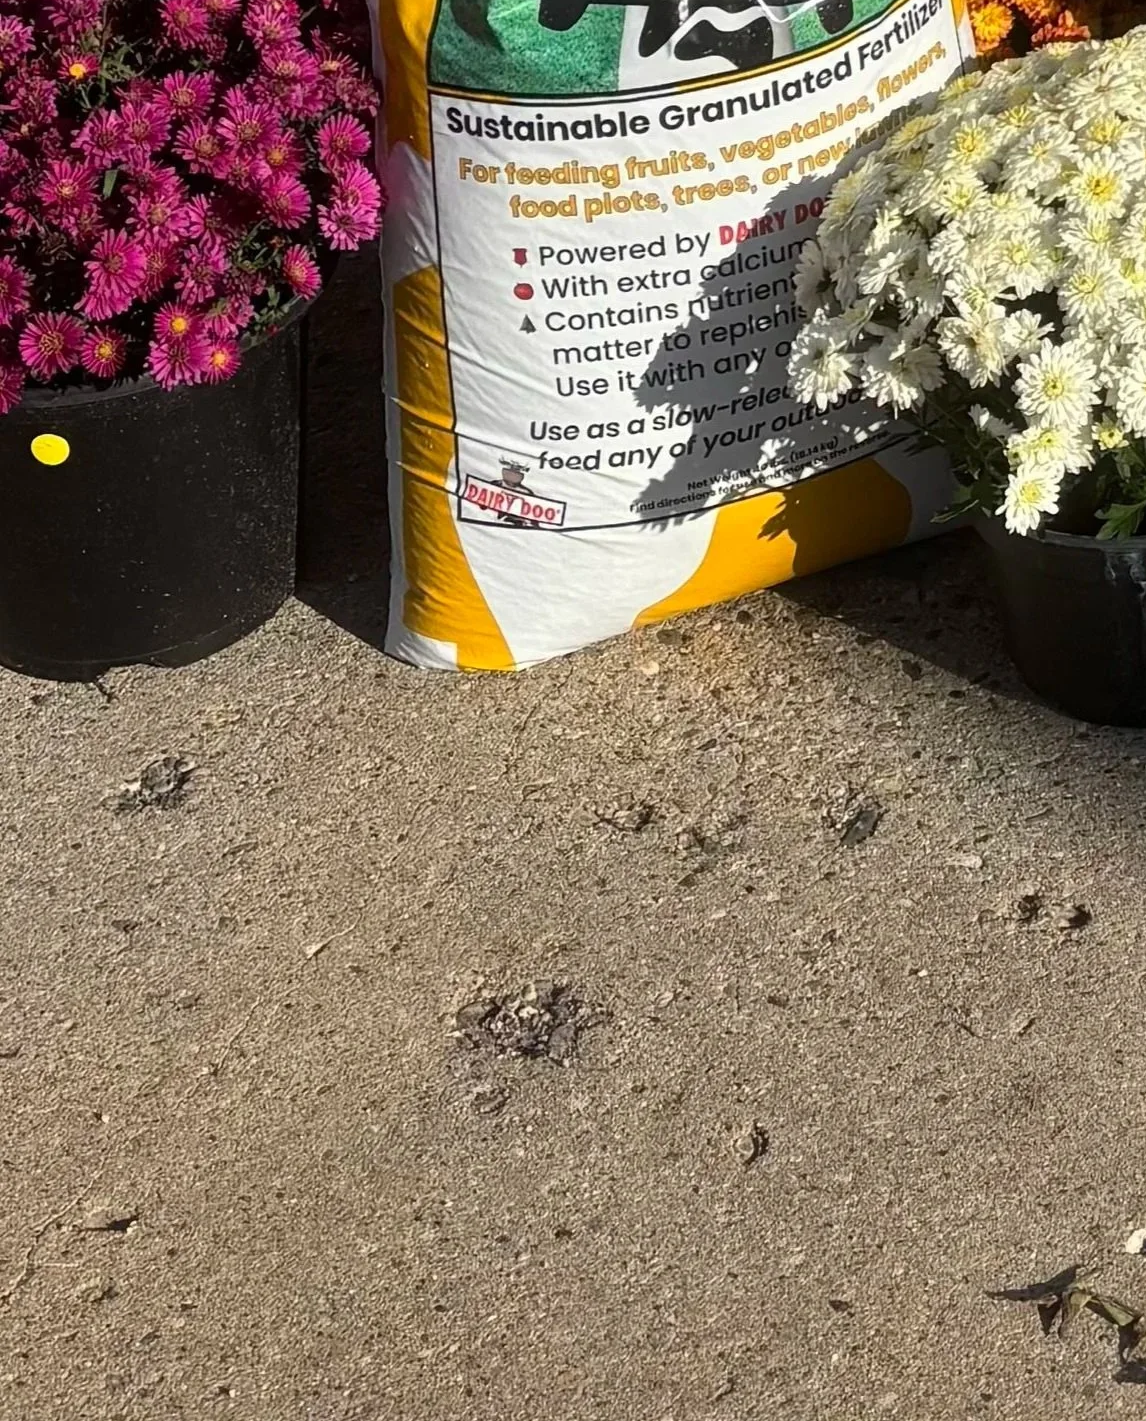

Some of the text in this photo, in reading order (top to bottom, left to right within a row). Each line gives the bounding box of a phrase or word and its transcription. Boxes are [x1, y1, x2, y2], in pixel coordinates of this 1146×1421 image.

[446, 106, 651, 142] Sustainable
[658, 52, 852, 130] Granulated
[458, 41, 946, 189] For feeding fruits, vegetables, flowers,
[509, 194, 578, 218] food
[583, 190, 669, 223] plots,
[672, 174, 757, 207] trees,
[762, 161, 793, 185] or
[539, 194, 829, 267] Powered by DAIRY DO
[542, 237, 821, 299] With extra calcium
[545, 271, 798, 333] Contains nutrient
[553, 300, 808, 365] matter to replenis
[556, 377, 609, 397] Use
[619, 371, 637, 392] it
[645, 360, 705, 388] with
[714, 347, 767, 378] any
[530, 420, 579, 441] Use
[587, 421, 620, 439] as
[627, 418, 646, 435] a
[538, 449, 601, 471] feed
[607, 444, 663, 469] any
[669, 434, 697, 459] of
[703, 420, 765, 458] your
[466, 483, 556, 521] DAIRY DOO
